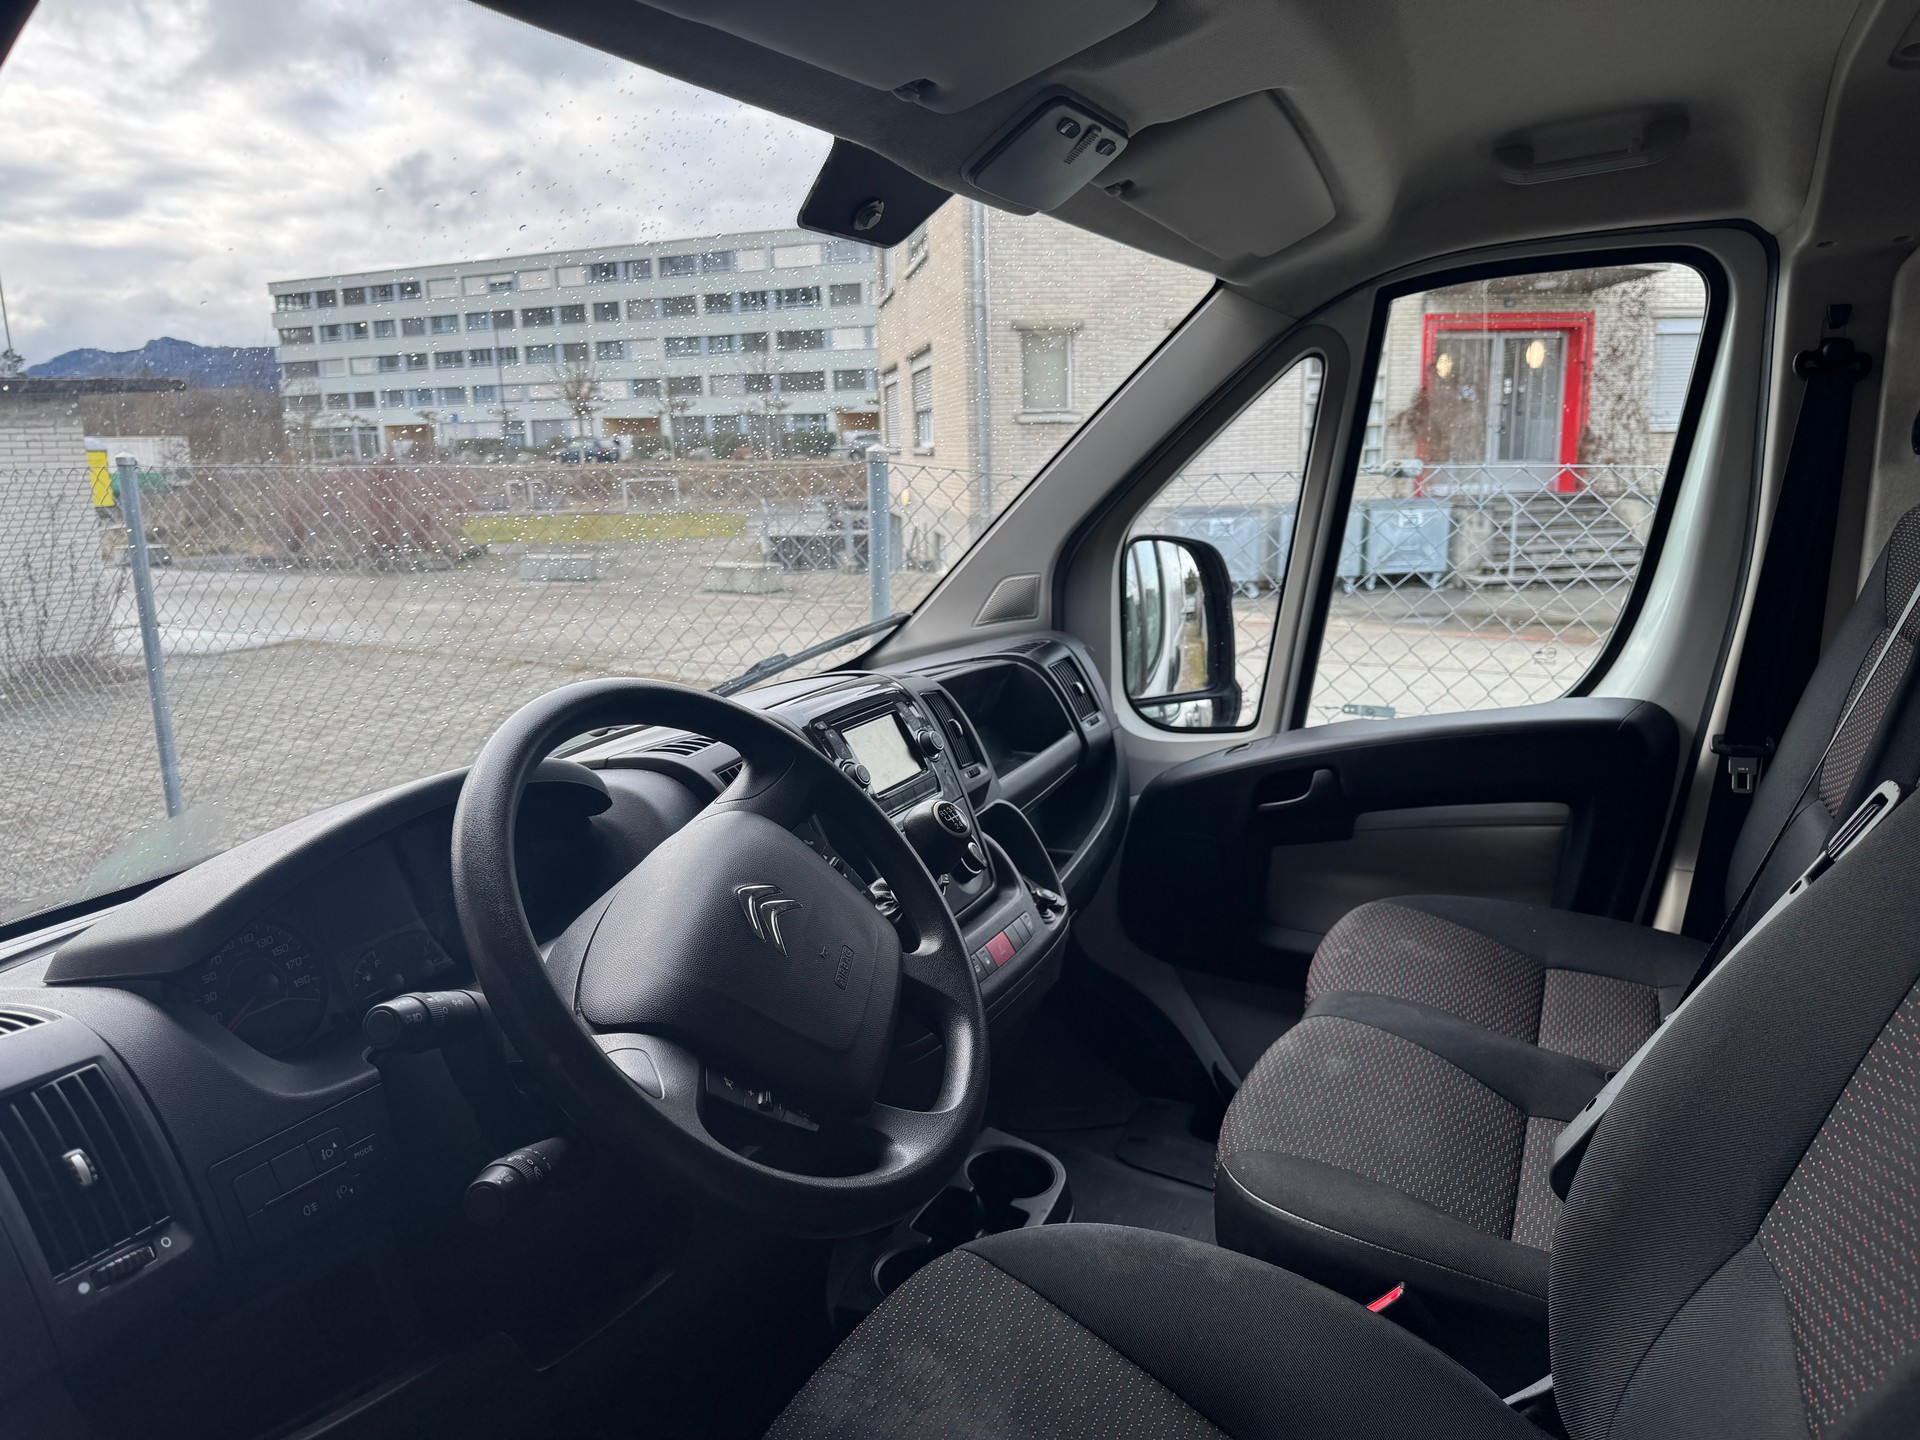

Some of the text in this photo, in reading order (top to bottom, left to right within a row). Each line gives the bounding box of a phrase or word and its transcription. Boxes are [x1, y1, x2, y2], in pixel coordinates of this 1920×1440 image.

[954, 822, 960, 830] 2
[239, 932, 255, 945] 110
[256, 935, 274, 949] 130
[271, 943, 289, 957] 150
[285, 956, 303, 970] 170
[837, 946, 853, 988] AIRBAG
[201, 971, 217, 985] 50
[293, 974, 311, 988] 190
[202, 991, 218, 1005] 30
[353, 1144, 374, 1159] MODE
